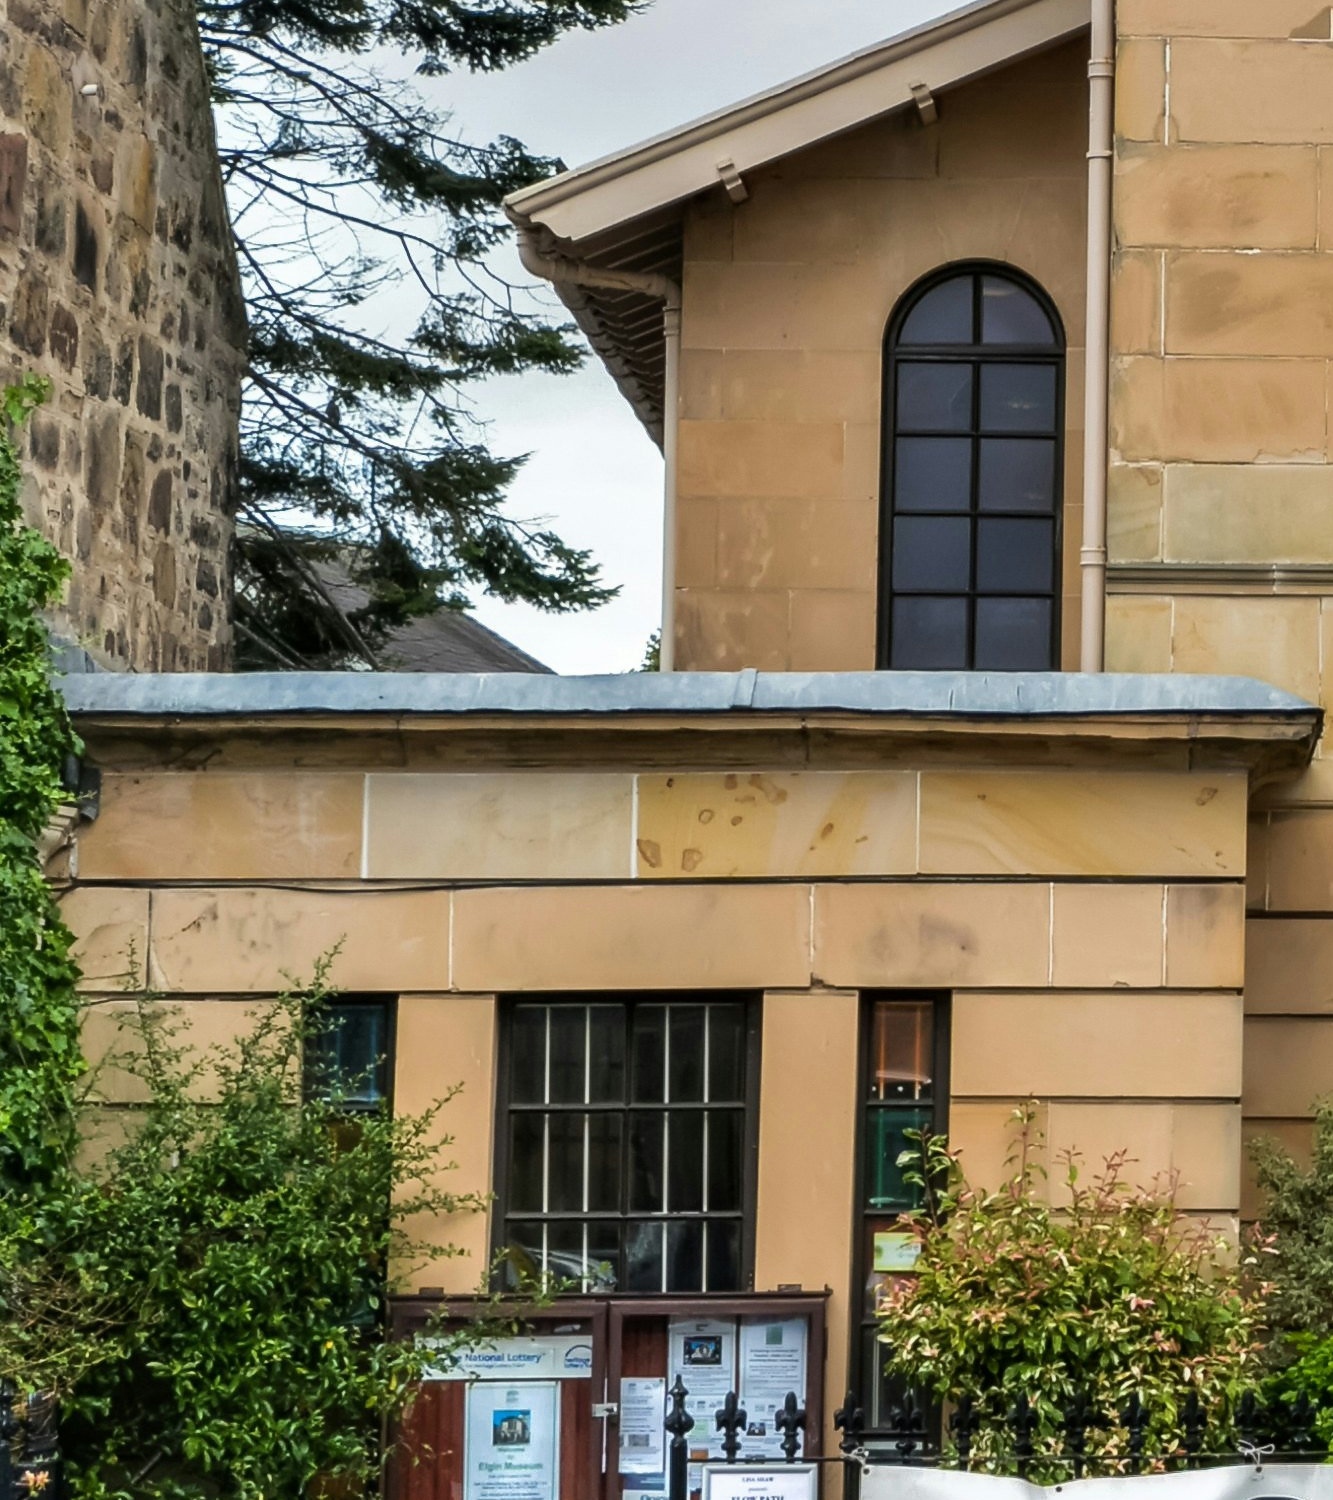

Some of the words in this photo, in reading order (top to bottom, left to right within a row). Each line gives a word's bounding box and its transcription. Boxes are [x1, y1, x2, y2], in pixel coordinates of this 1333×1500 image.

[465, 1352, 505, 1362] National
[507, 1352, 542, 1365] Lottery
[478, 1462, 502, 1472] Elgin
[504, 1462, 543, 1470] Museum
